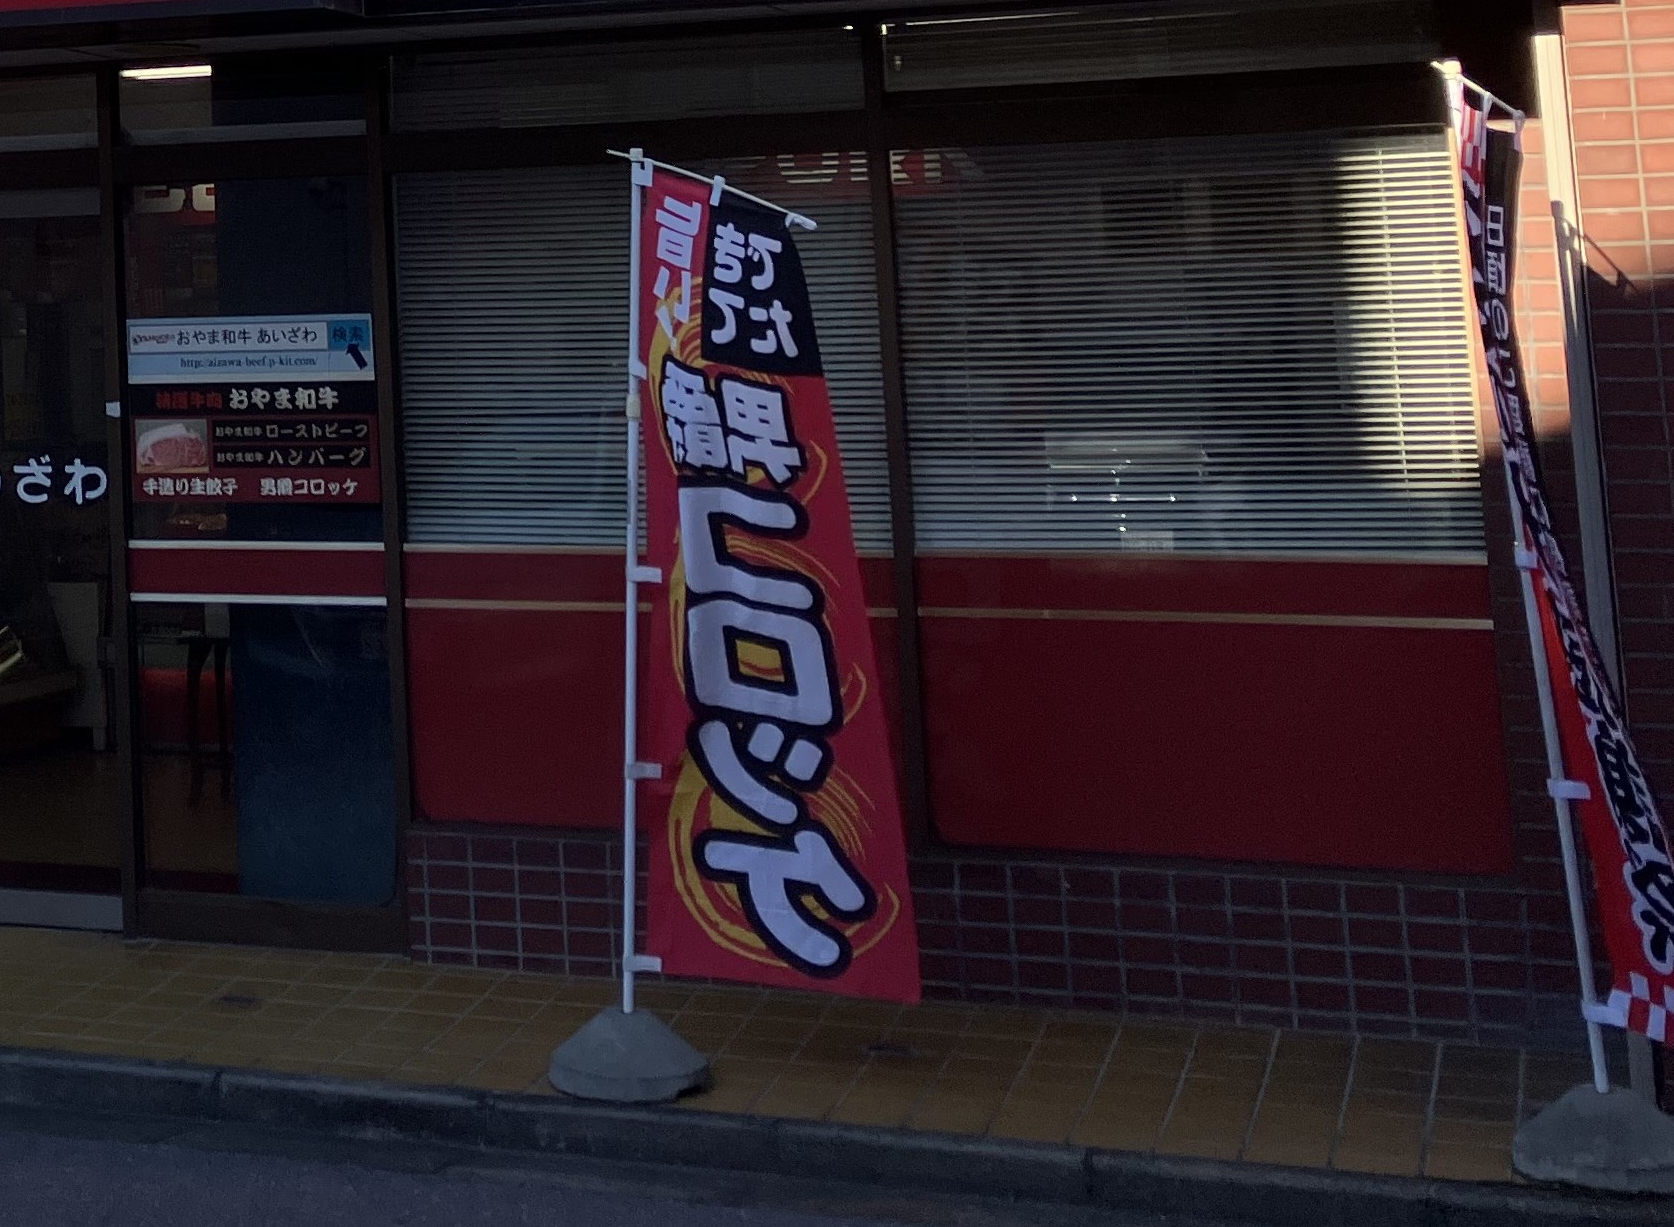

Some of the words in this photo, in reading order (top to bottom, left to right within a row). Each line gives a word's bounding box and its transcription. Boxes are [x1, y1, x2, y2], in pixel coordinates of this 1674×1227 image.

[176, 328, 251, 346] おやま和牛
[256, 326, 318, 344] あいざわ
[331, 325, 365, 344] 検索
[228, 386, 340, 410] おやま和牛
[267, 446, 367, 466] ハンバーグ
